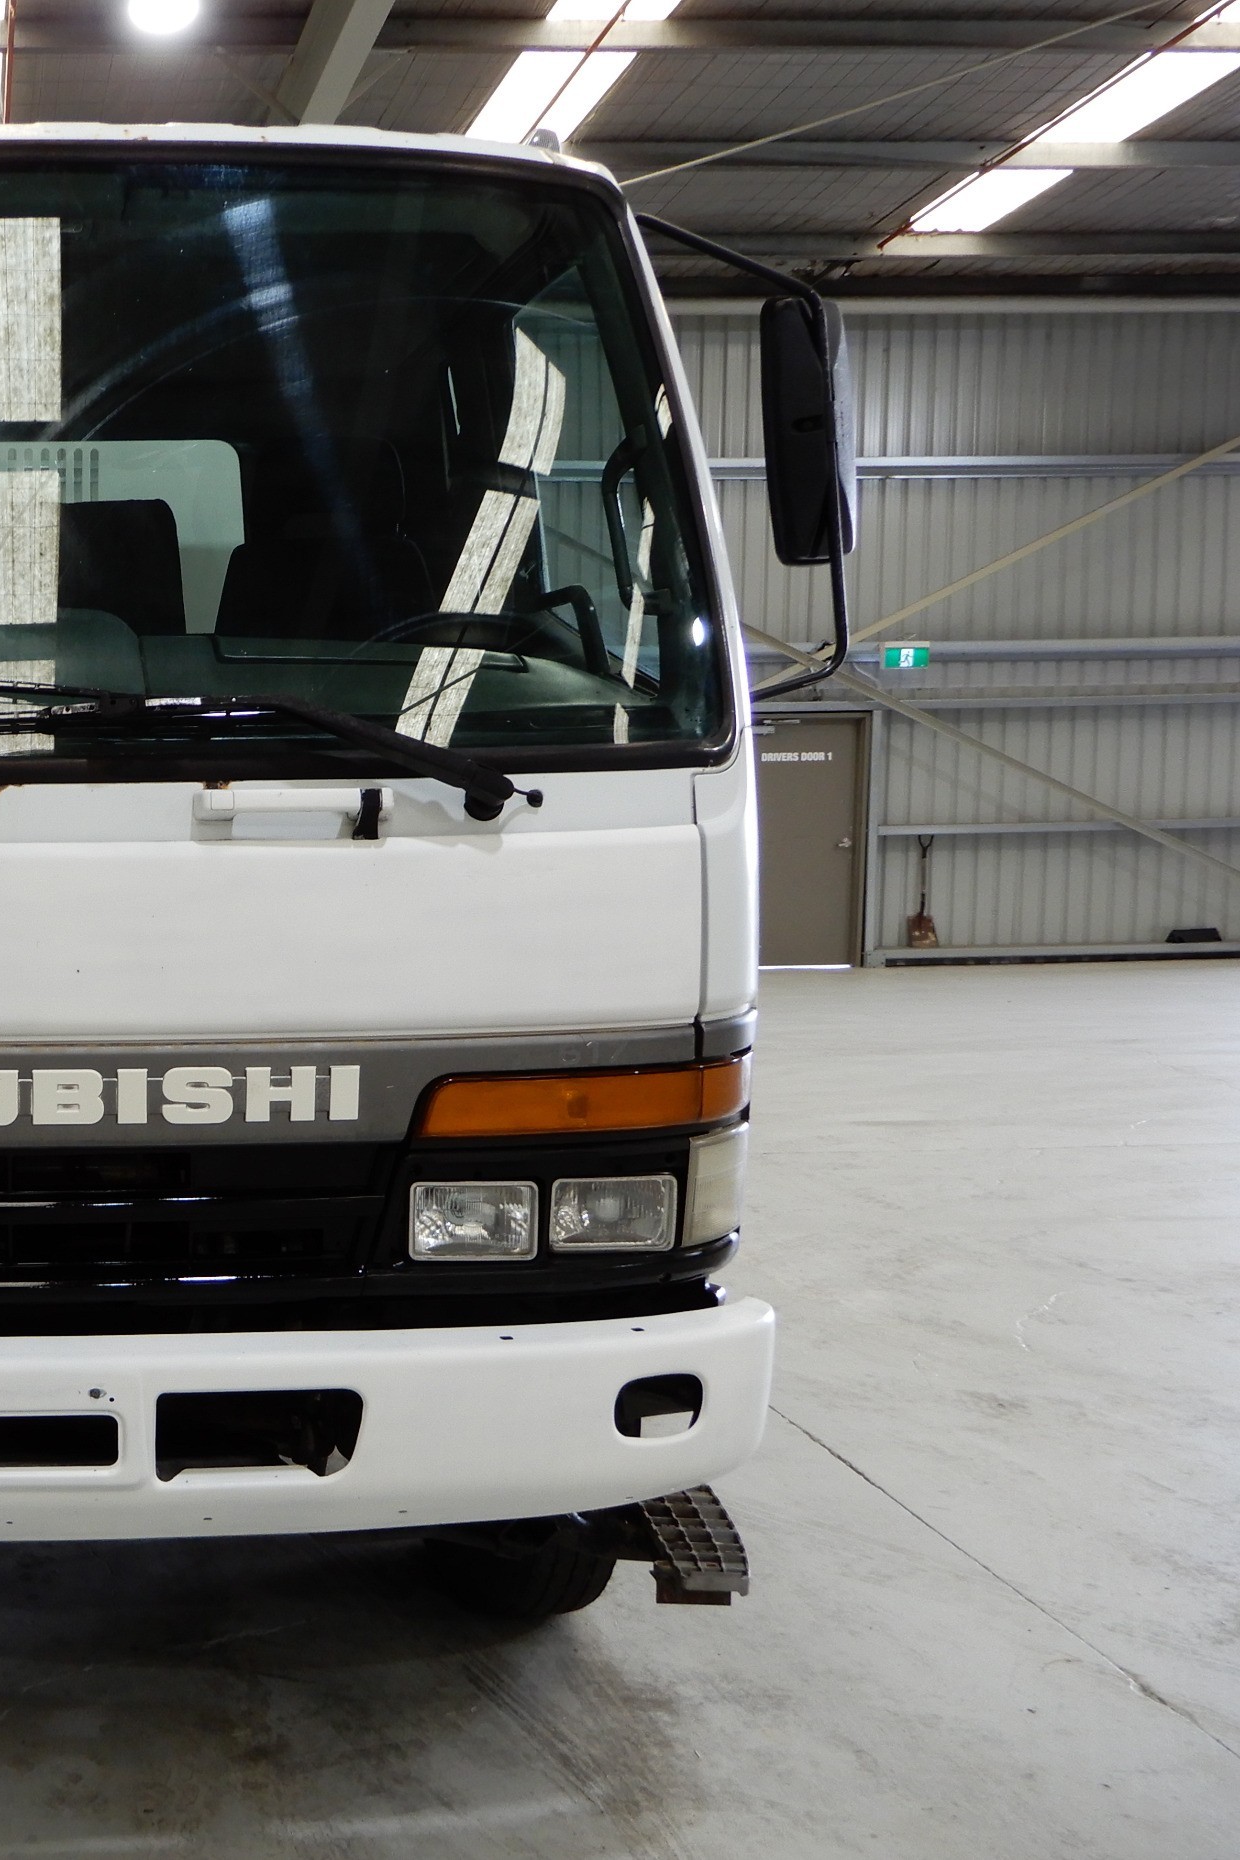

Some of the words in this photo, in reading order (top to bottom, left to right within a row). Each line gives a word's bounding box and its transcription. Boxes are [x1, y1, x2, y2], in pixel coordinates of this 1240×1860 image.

[761, 752, 799, 762] DRIVERS
[800, 752, 825, 761] DOOR
[827, 752, 832, 760] 1
